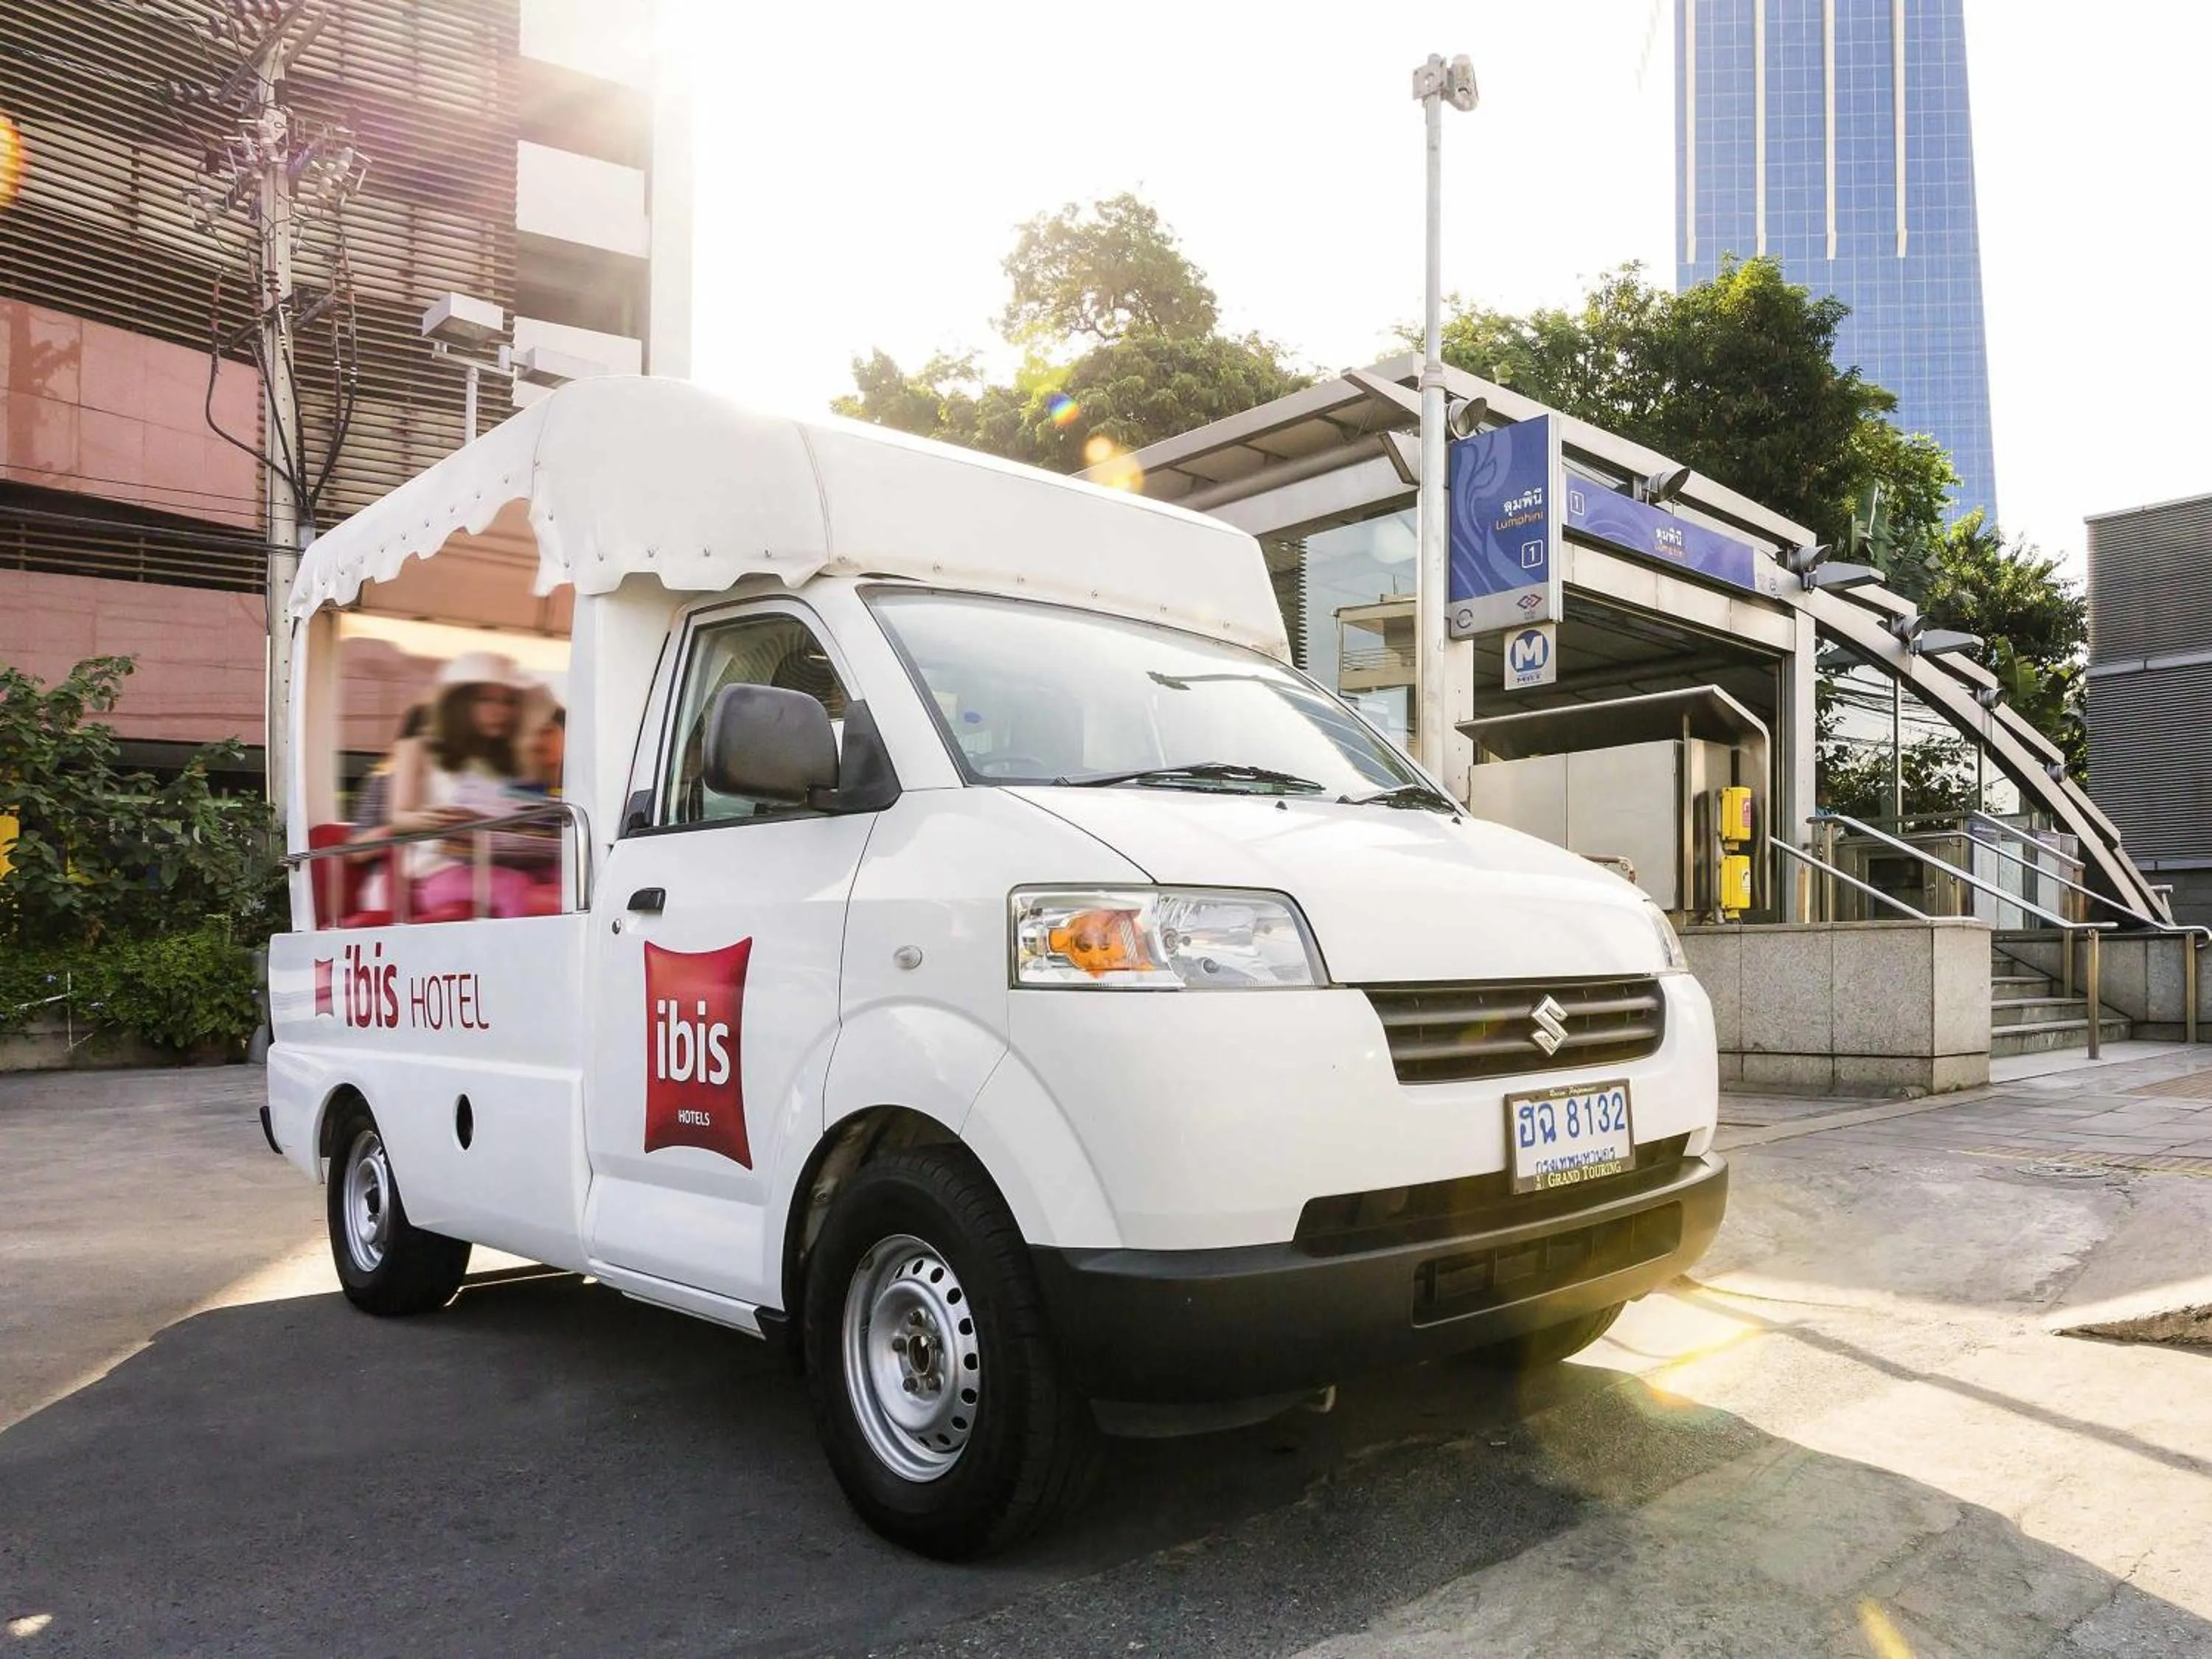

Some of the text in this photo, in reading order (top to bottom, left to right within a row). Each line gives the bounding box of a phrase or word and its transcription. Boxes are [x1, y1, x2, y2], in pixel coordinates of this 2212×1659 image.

[1515, 635, 1544, 669] M
[344, 942, 490, 1030] ibis HOTEL
[657, 999, 730, 1085] ibis
[678, 1109, 711, 1127] HOTELS
[1566, 1091, 1626, 1138] 8132
[1536, 1146, 1615, 1175] กรงเทพมหานคร
[1548, 1169, 1580, 1188] GRAND
[1582, 1160, 1622, 1180] TOURING
